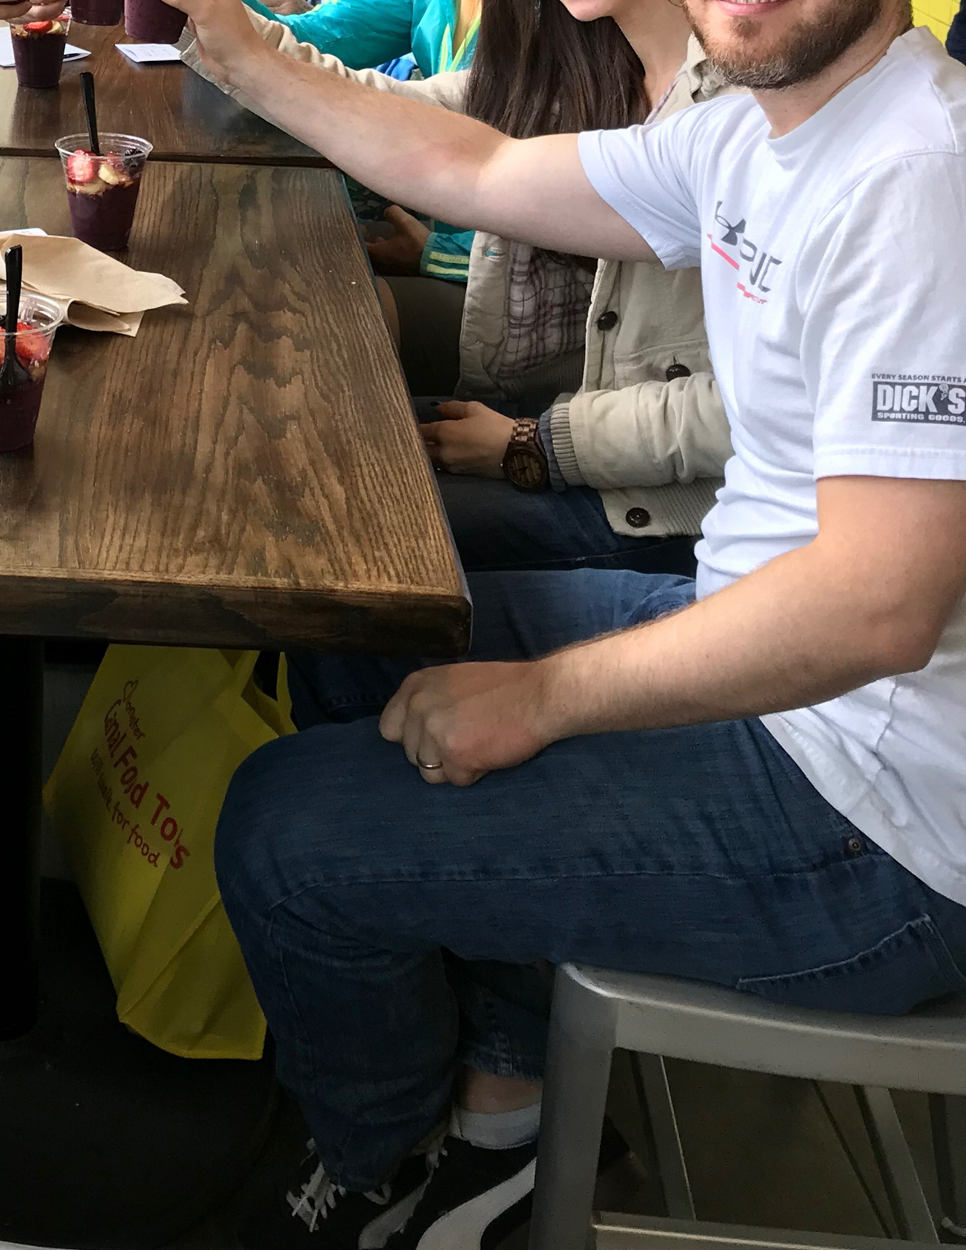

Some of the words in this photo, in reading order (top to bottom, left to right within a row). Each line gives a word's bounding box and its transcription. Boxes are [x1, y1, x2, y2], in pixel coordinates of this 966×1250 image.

[931, 375, 962, 383] STARTS
[876, 383, 966, 414] DICK'S
[877, 412, 924, 420] SPORTING
[111, 801, 130, 831] for
[127, 824, 161, 868] food
